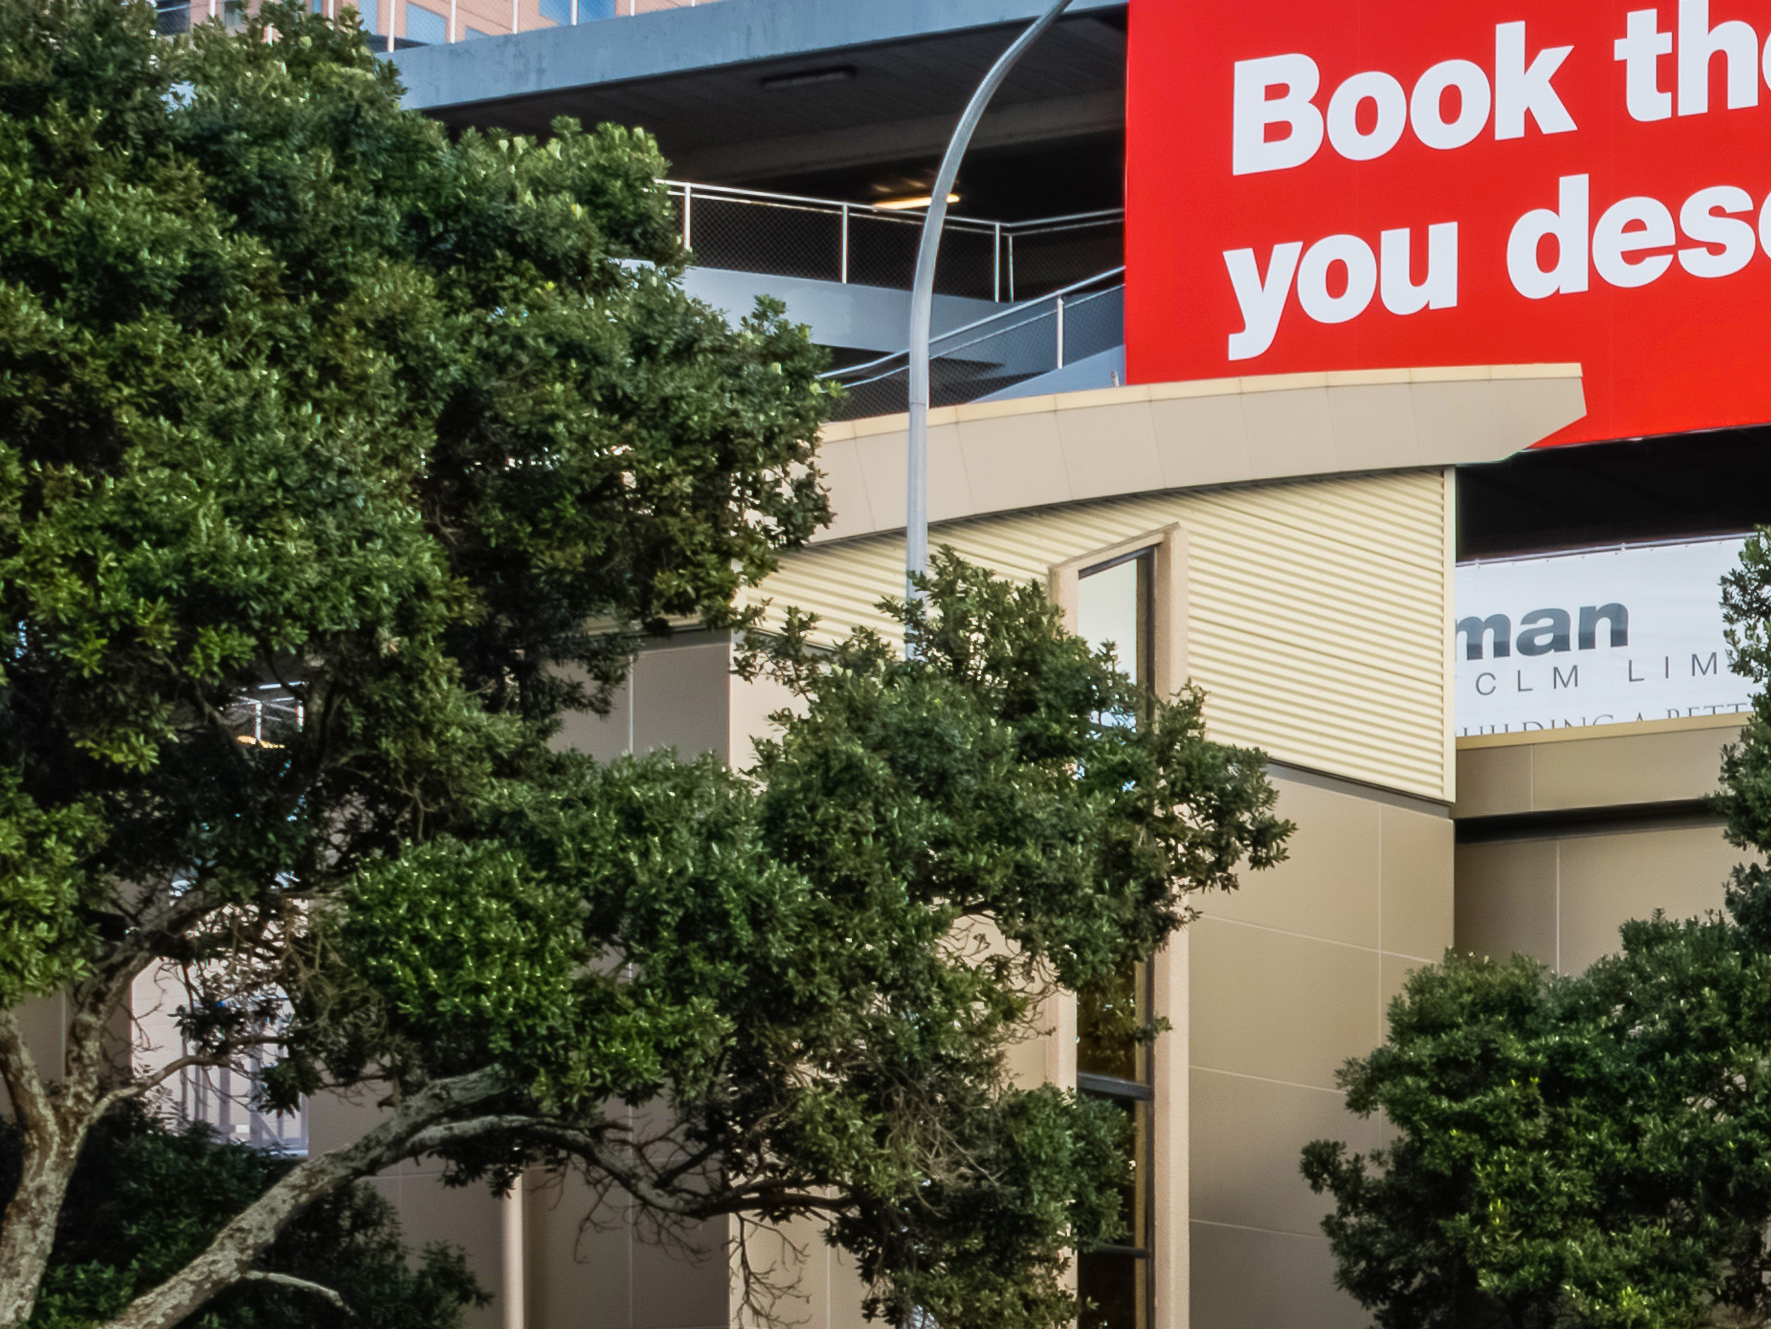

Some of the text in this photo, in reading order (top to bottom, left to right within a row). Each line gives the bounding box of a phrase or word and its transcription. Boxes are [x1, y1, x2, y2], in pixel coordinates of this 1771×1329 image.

[1232, 20, 1578, 176] Book
[1222, 221, 1459, 361] you
[1456, 602, 1629, 661] man
[1475, 652, 1729, 696] CLM LIM
